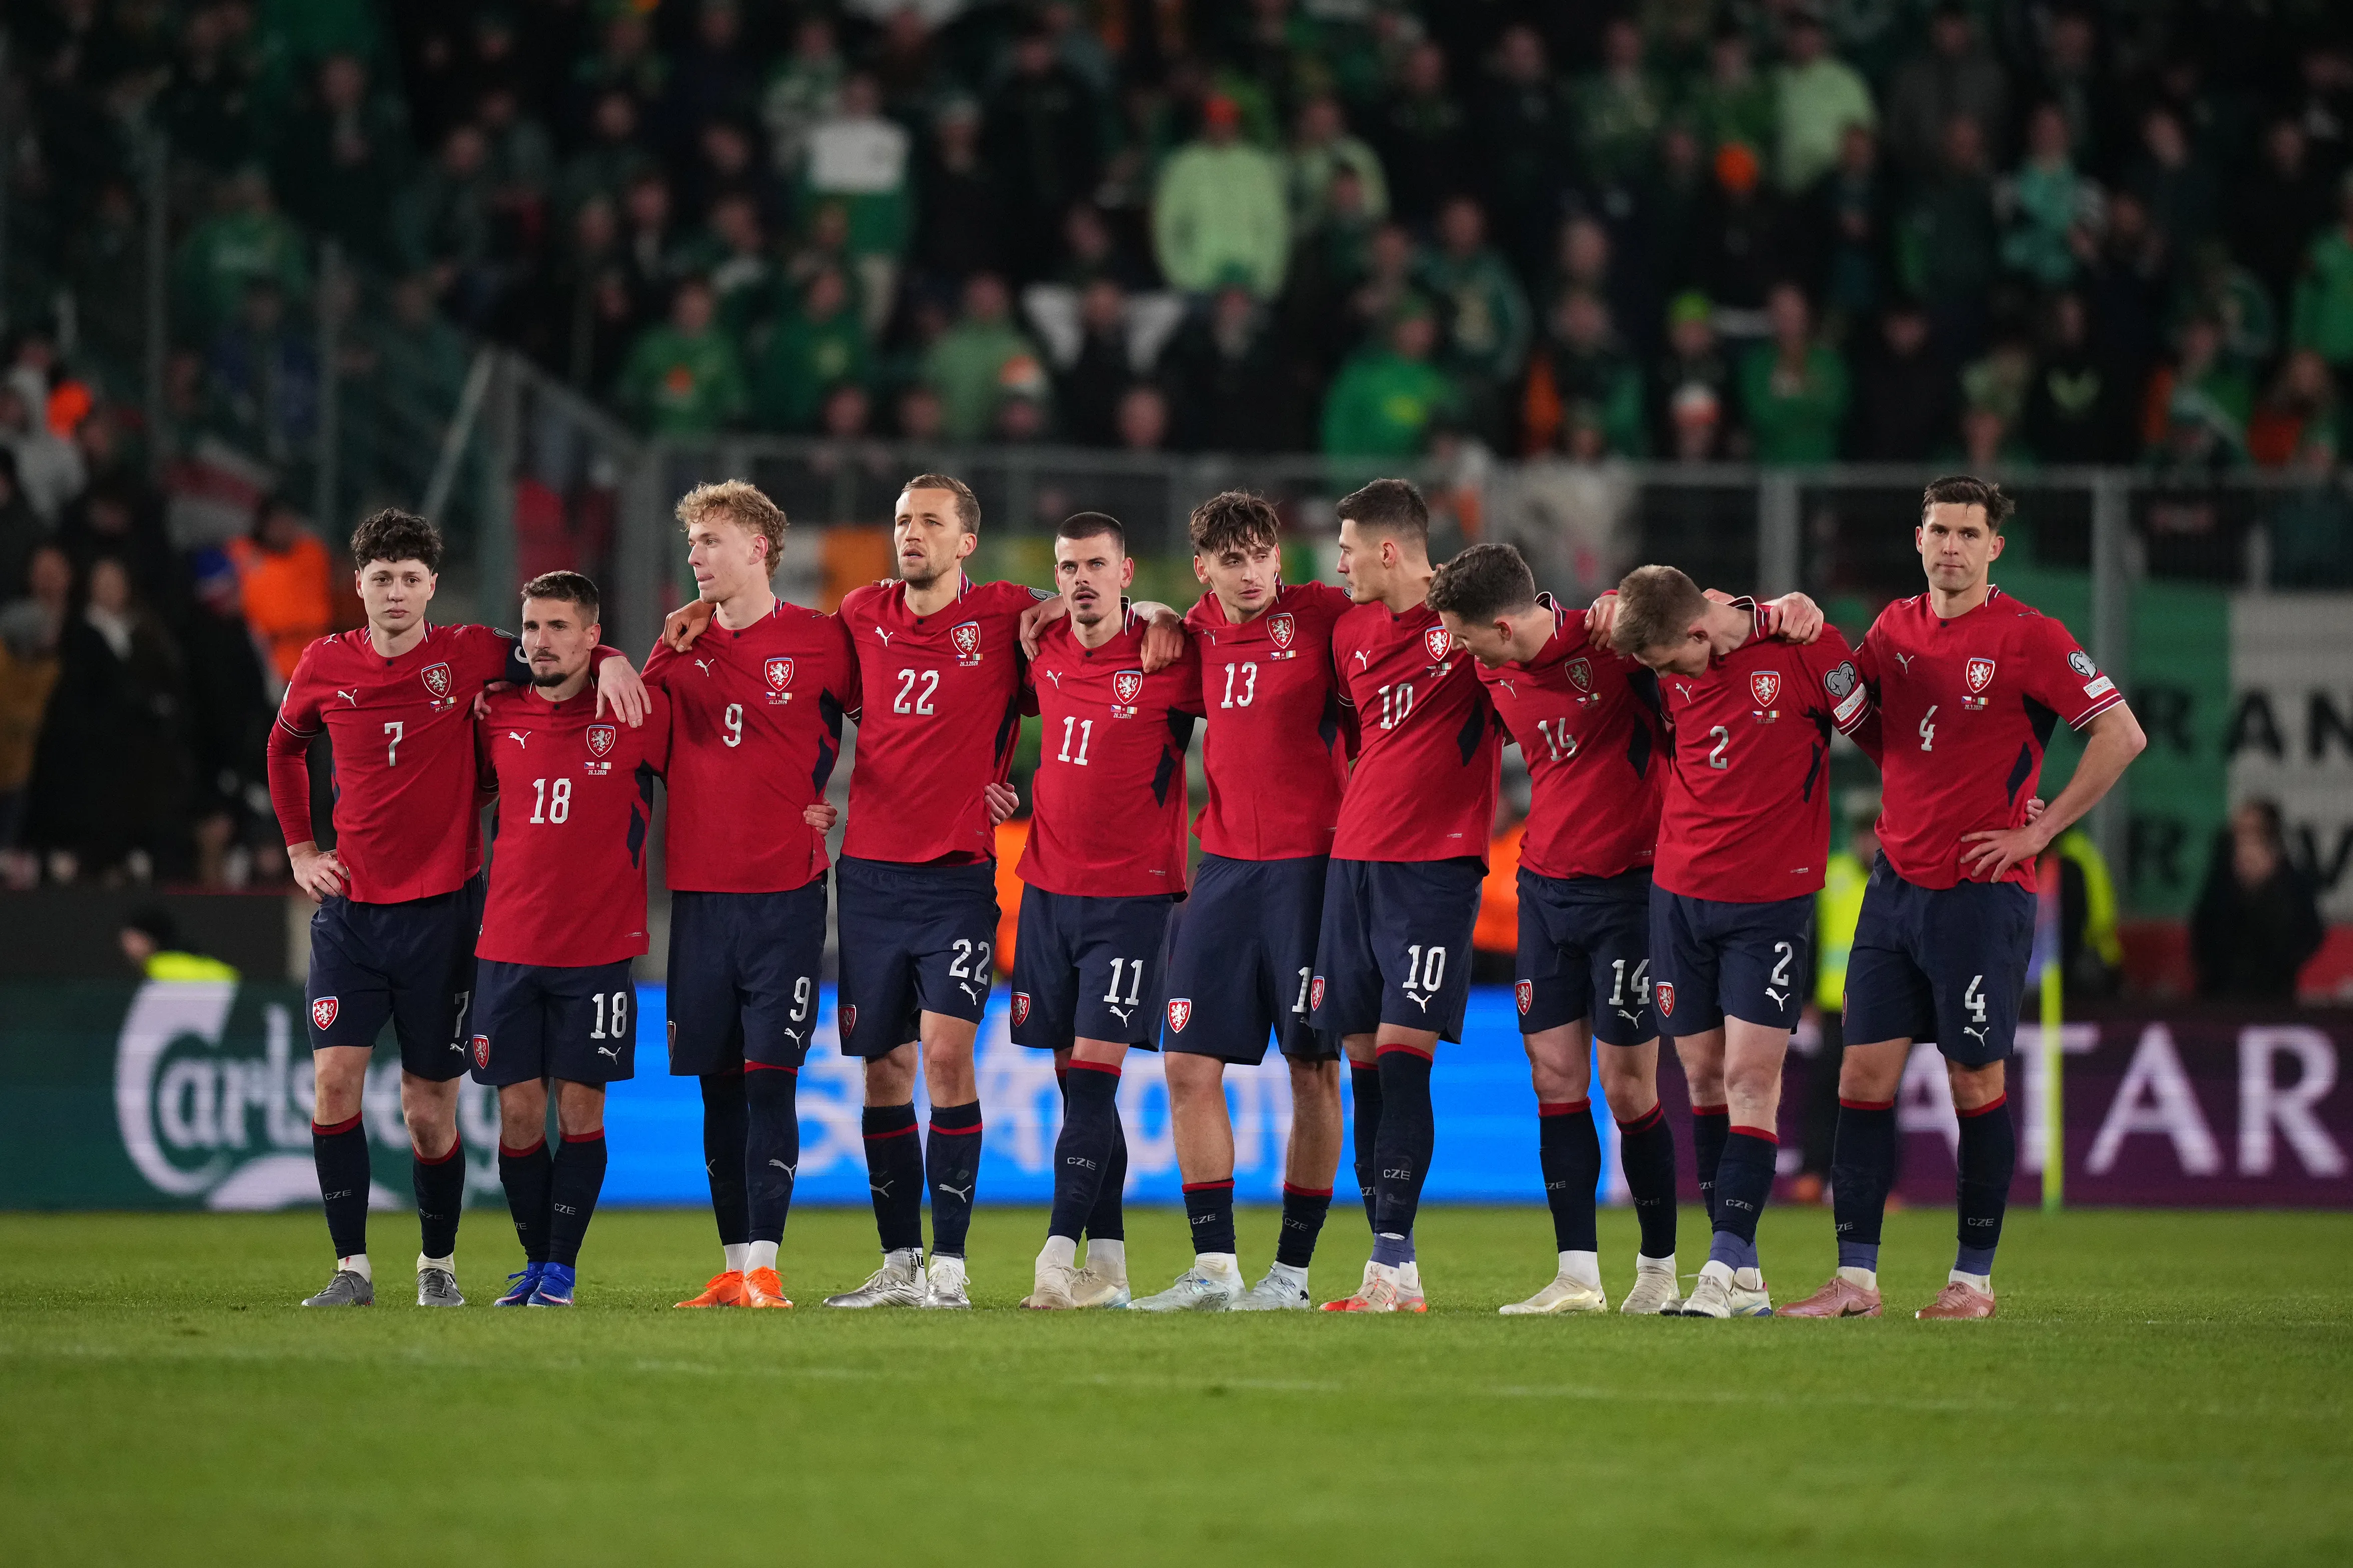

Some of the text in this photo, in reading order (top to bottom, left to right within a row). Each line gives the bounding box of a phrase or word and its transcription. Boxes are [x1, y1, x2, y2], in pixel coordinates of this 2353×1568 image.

[894, 669, 939, 715] 22
[1221, 662, 1257, 708] 13
[1378, 683, 1413, 730] 10
[384, 722, 403, 766] 7
[723, 703, 743, 747] 9
[1058, 716, 1093, 766] 11
[1537, 718, 1578, 762] 14
[1710, 726, 1729, 769] 2
[1919, 705, 1938, 752] 4
[530, 778, 571, 823] 18
[949, 938, 991, 985] 22
[1103, 958, 1144, 1006] 11
[1402, 944, 1446, 991] 10
[1609, 959, 1650, 1005] 14
[1771, 941, 1793, 986] 2
[790, 977, 811, 1022] 9
[1292, 967, 1312, 1012] 1
[1965, 975, 1986, 1022] 4
[454, 991, 469, 1038] 7
[590, 992, 627, 1039] 18
[115, 979, 502, 1195] Carleg
[1067, 1157, 1096, 1170] CZE
[1383, 1169, 1410, 1180] CZE
[325, 1189, 351, 1200] CZE
[420, 1208, 444, 1220] CZE
[554, 1203, 576, 1215] CZE
[1726, 1199, 1753, 1211] CZE
[515, 1222, 527, 1230] ZE
[1192, 1214, 1216, 1225] CZE
[1284, 1218, 1308, 1232] CZE
[1836, 1222, 1853, 1231] ZE
[1967, 1217, 1995, 1227] CZE
